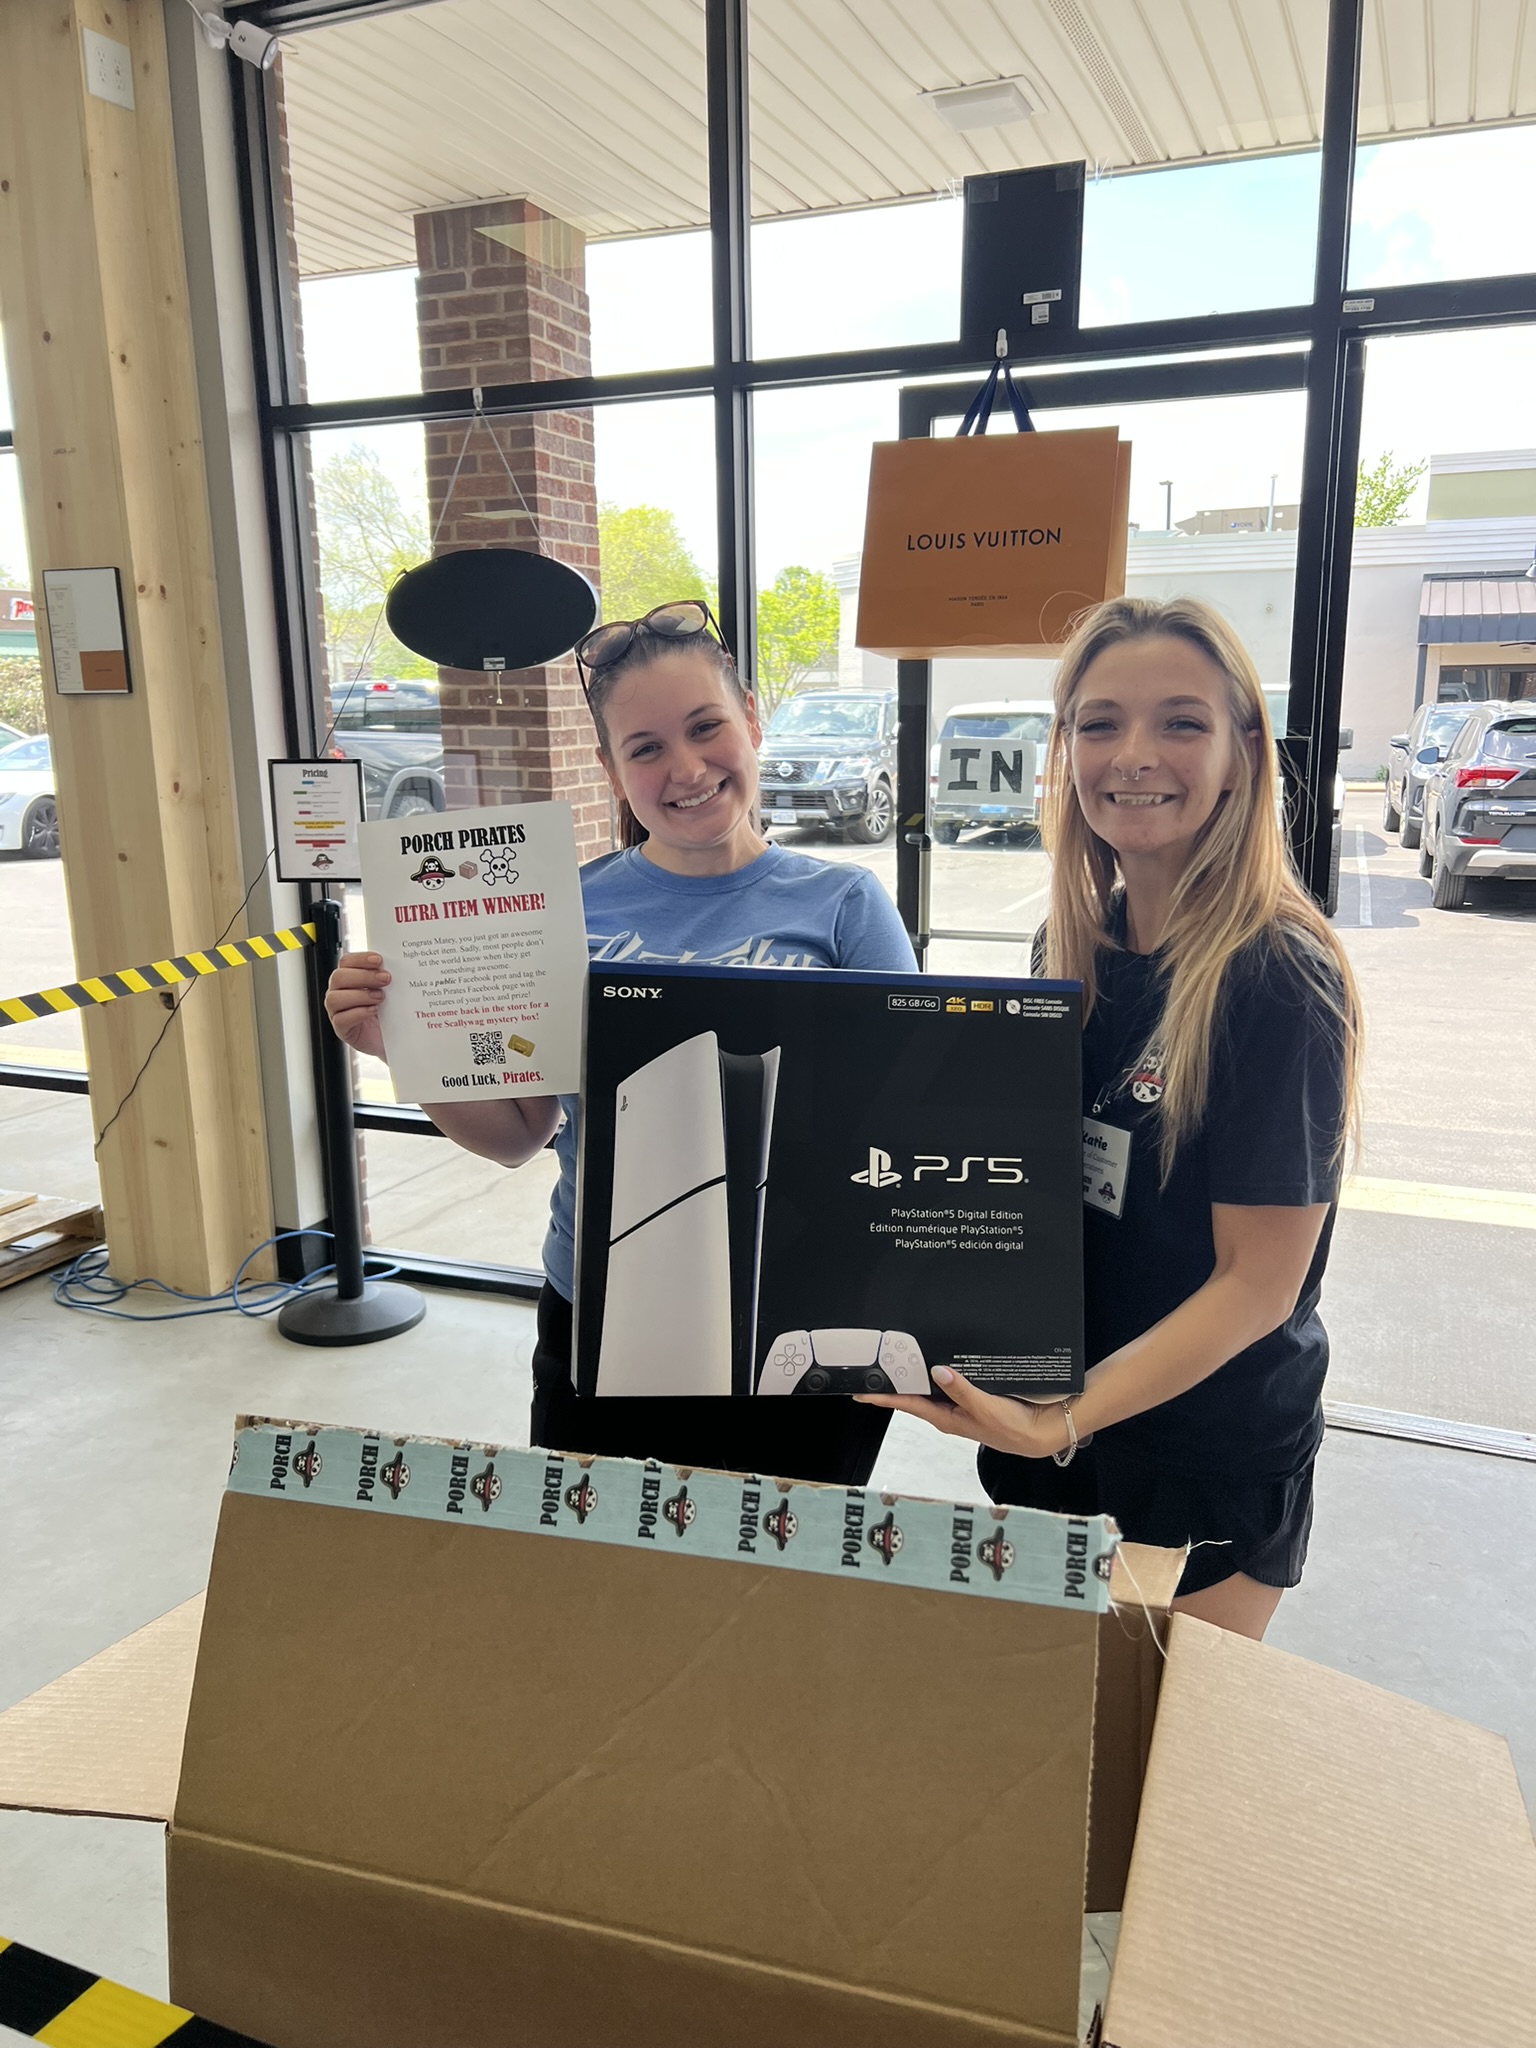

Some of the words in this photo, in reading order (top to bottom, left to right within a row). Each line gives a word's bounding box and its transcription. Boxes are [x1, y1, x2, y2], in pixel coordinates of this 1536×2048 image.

[907, 533, 966, 551] LOUIS
[973, 527, 1061, 548] VUITTON
[302, 769, 329, 778] Pricing
[947, 748, 1023, 794] IN
[401, 831, 454, 855] PORCH
[458, 824, 526, 849] PIRATES
[395, 904, 439, 924] ULTRA
[443, 899, 479, 919] ITEM
[482, 893, 546, 915] WINNER!
[402, 940, 433, 950] Congrats
[434, 937, 458, 948] Matey,
[459, 936, 472, 944] you
[473, 934, 486, 943] just
[488, 933, 500, 941] got
[511, 930, 543, 938] awesome
[403, 949, 440, 958] high-ticket
[442, 947, 457, 955] item.
[460, 944, 482, 953] Sadly,
[483, 943, 500, 951] most
[502, 941, 525, 950] people
[526, 938, 545, 947] don't
[419, 959, 428, 967] let
[429, 958, 440, 967] the
[441, 956, 462, 965] world
[463, 955, 482, 964] know
[483, 953, 502, 962] when
[504, 952, 519, 961] they
[520, 951, 531, 959] get
[409, 980, 428, 989] Make
[435, 978, 457, 988] public
[458, 974, 491, 984] Facebook
[493, 974, 508, 982] post
[509, 971, 522, 980] and
[523, 971, 535, 979] tag
[535, 969, 547, 977] the
[441, 966, 476, 976] something
[477, 964, 511, 972] awesome.
[422, 988, 442, 998] Porch
[443, 986, 466, 996] Pirates
[467, 984, 500, 994] Facebook
[502, 983, 519, 992] page
[520, 981, 536, 989] with
[429, 999, 455, 1008] pictures
[456, 997, 464, 1005] of
[465, 997, 482, 1006] your
[482, 994, 496, 1002] box
[497, 993, 511, 1001] and
[511, 991, 531, 1001] prize!
[603, 986, 662, 999] SONY
[416, 1010, 437, 1019] Then
[438, 1009, 458, 1017] come
[460, 1007, 480, 1015] back
[482, 1005, 491, 1014] in
[492, 1004, 506, 1013] the
[507, 1003, 529, 1011] store
[530, 1001, 543, 1009] for
[892, 998, 907, 1008] 825
[908, 999, 937, 1009] GB/Go
[946, 997, 967, 1005] 4K
[973, 1002, 992, 1010] HDR
[427, 1021, 443, 1030] free
[444, 1018, 485, 1029] Scallywag
[486, 1016, 519, 1025] mystery
[521, 1012, 540, 1022] box!
[442, 1074, 470, 1088] Good
[471, 1072, 501, 1087] Luck,
[503, 1070, 545, 1085] Pirates.
[914, 1156, 1023, 1184] PS5
[957, 1210, 988, 1221] Digital
[991, 1210, 1023, 1220] Edition
[870, 1222, 904, 1233] Édition
[906, 1224, 959, 1235] numérique
[959, 1239, 993, 1250] edición
[995, 1241, 1024, 1252] digital
[271, 1435, 292, 1491] PORCH
[357, 1445, 380, 1502] PORCH
[447, 1455, 469, 1514] PORCH
[540, 1466, 563, 1527] PORCH
[638, 1478, 662, 1540] PORCH
[738, 1489, 762, 1554] PORCH
[842, 1503, 865, 1568] PORCH
[950, 1518, 974, 1584] PORCH
[1064, 1532, 1089, 1600] PORCH
